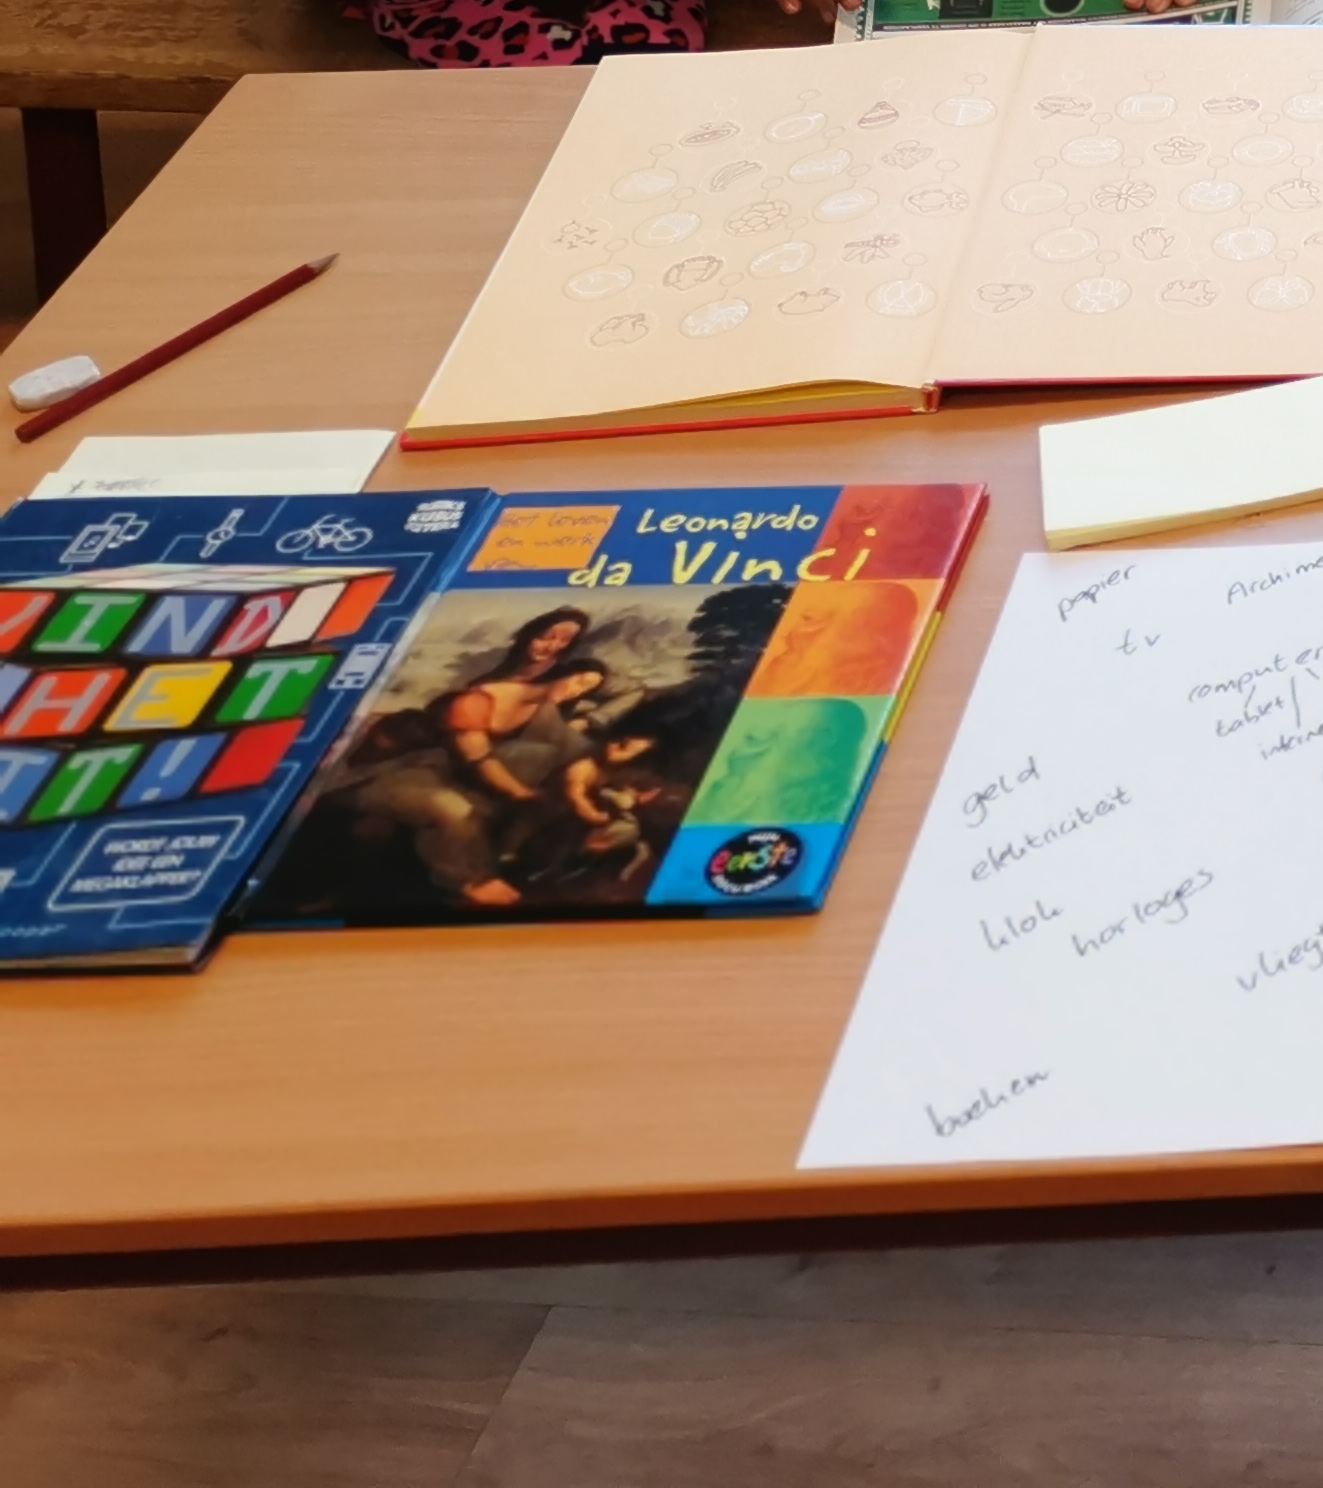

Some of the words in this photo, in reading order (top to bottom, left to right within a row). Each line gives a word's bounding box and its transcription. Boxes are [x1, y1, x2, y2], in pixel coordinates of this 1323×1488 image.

[636, 504, 819, 537] Leonardo
[568, 547, 633, 588] da
[671, 526, 878, 586] Vinci
[1056, 563, 1137, 621] papier
[4, 661, 318, 737] HET
[962, 755, 1042, 829] geld
[978, 898, 1064, 952] klok
[1071, 868, 1216, 958] horloges
